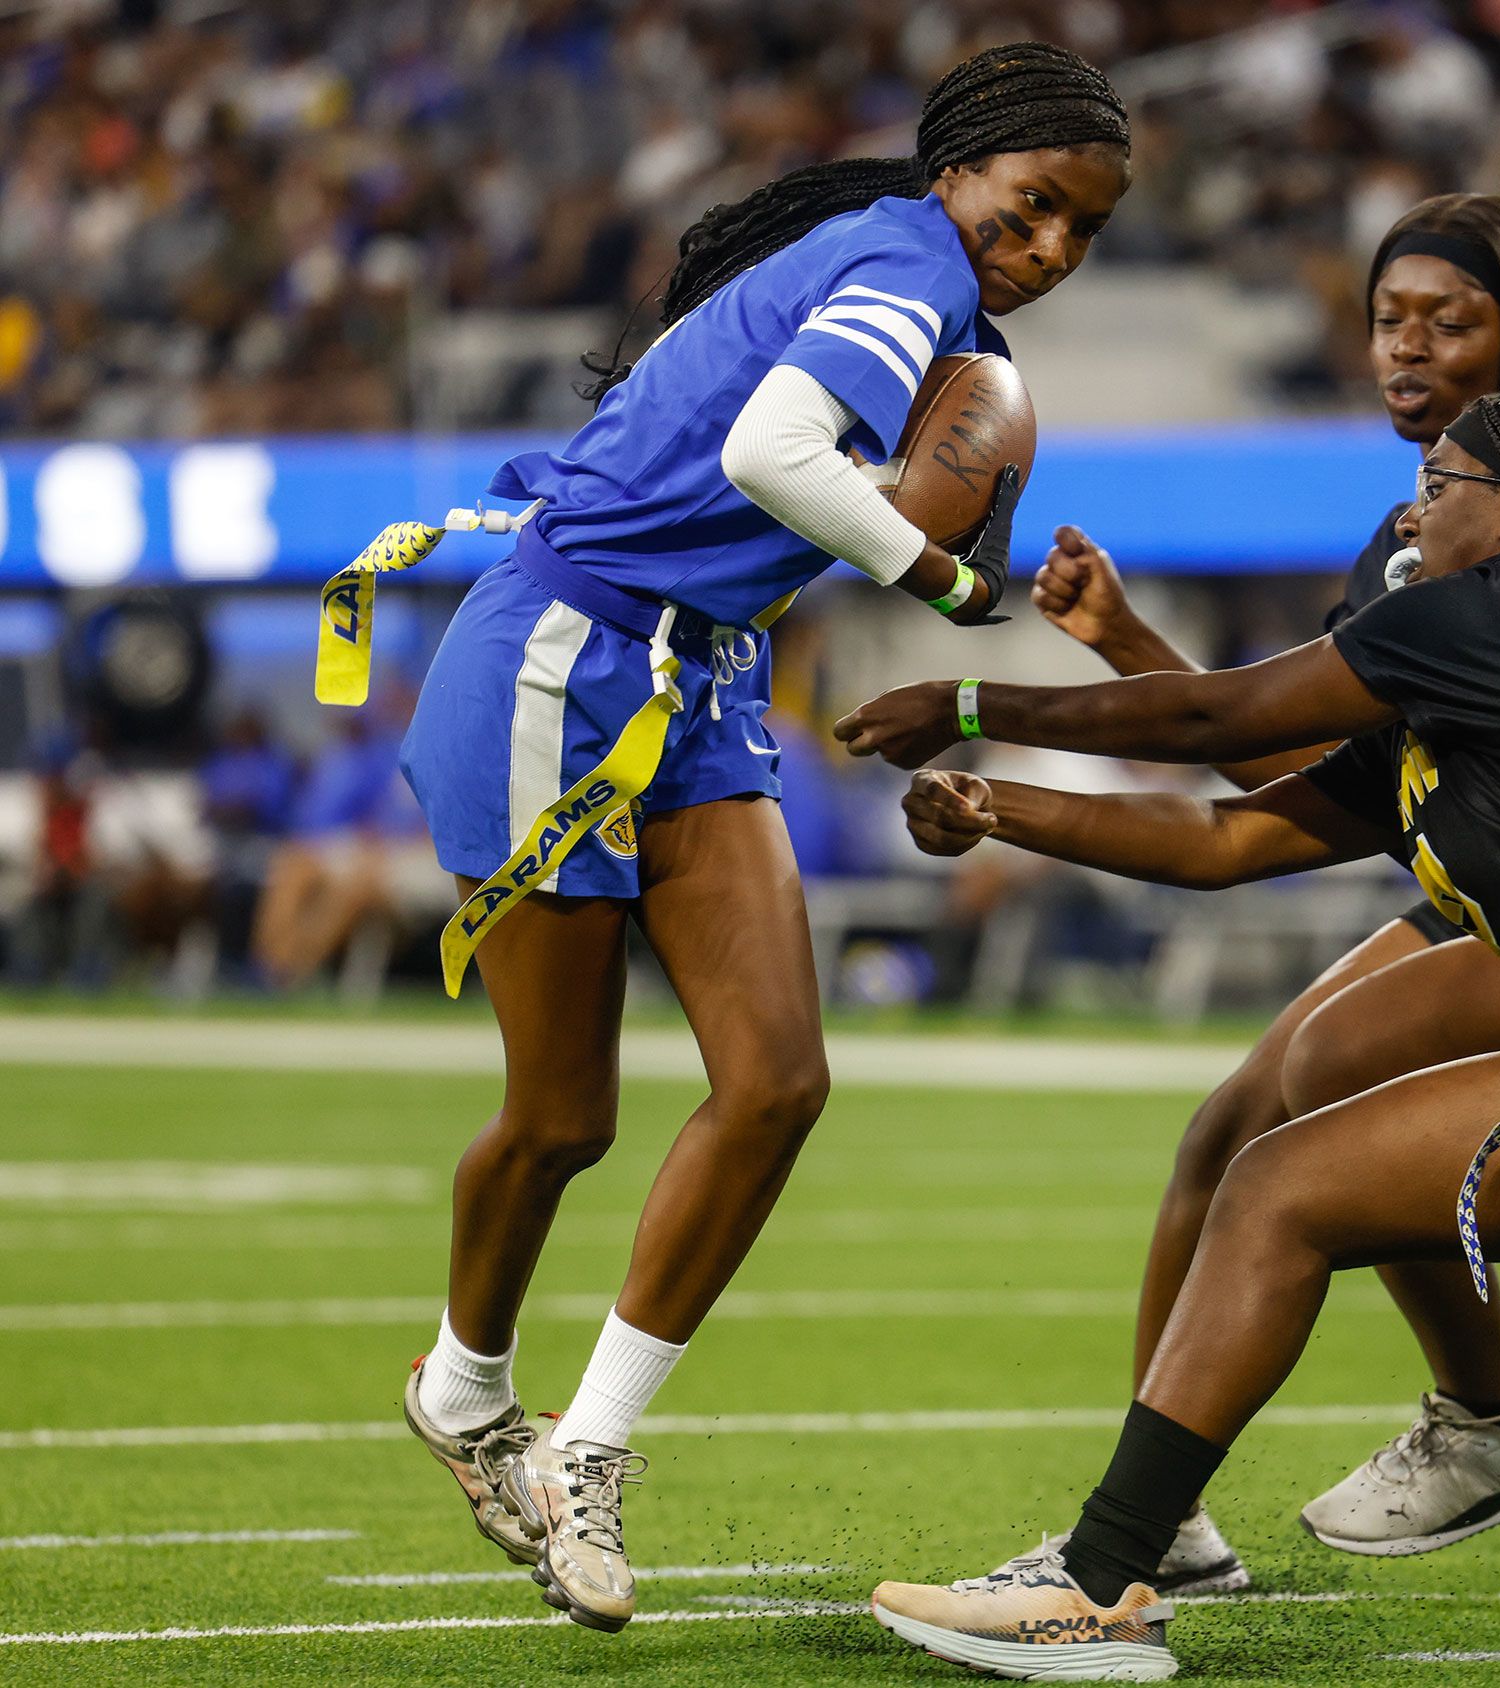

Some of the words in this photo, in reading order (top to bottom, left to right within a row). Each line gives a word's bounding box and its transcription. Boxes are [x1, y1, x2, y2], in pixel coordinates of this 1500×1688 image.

[460, 886, 514, 938] LA
[510, 779, 618, 888] RAMS
[1018, 1615, 1105, 1645] HOKA
